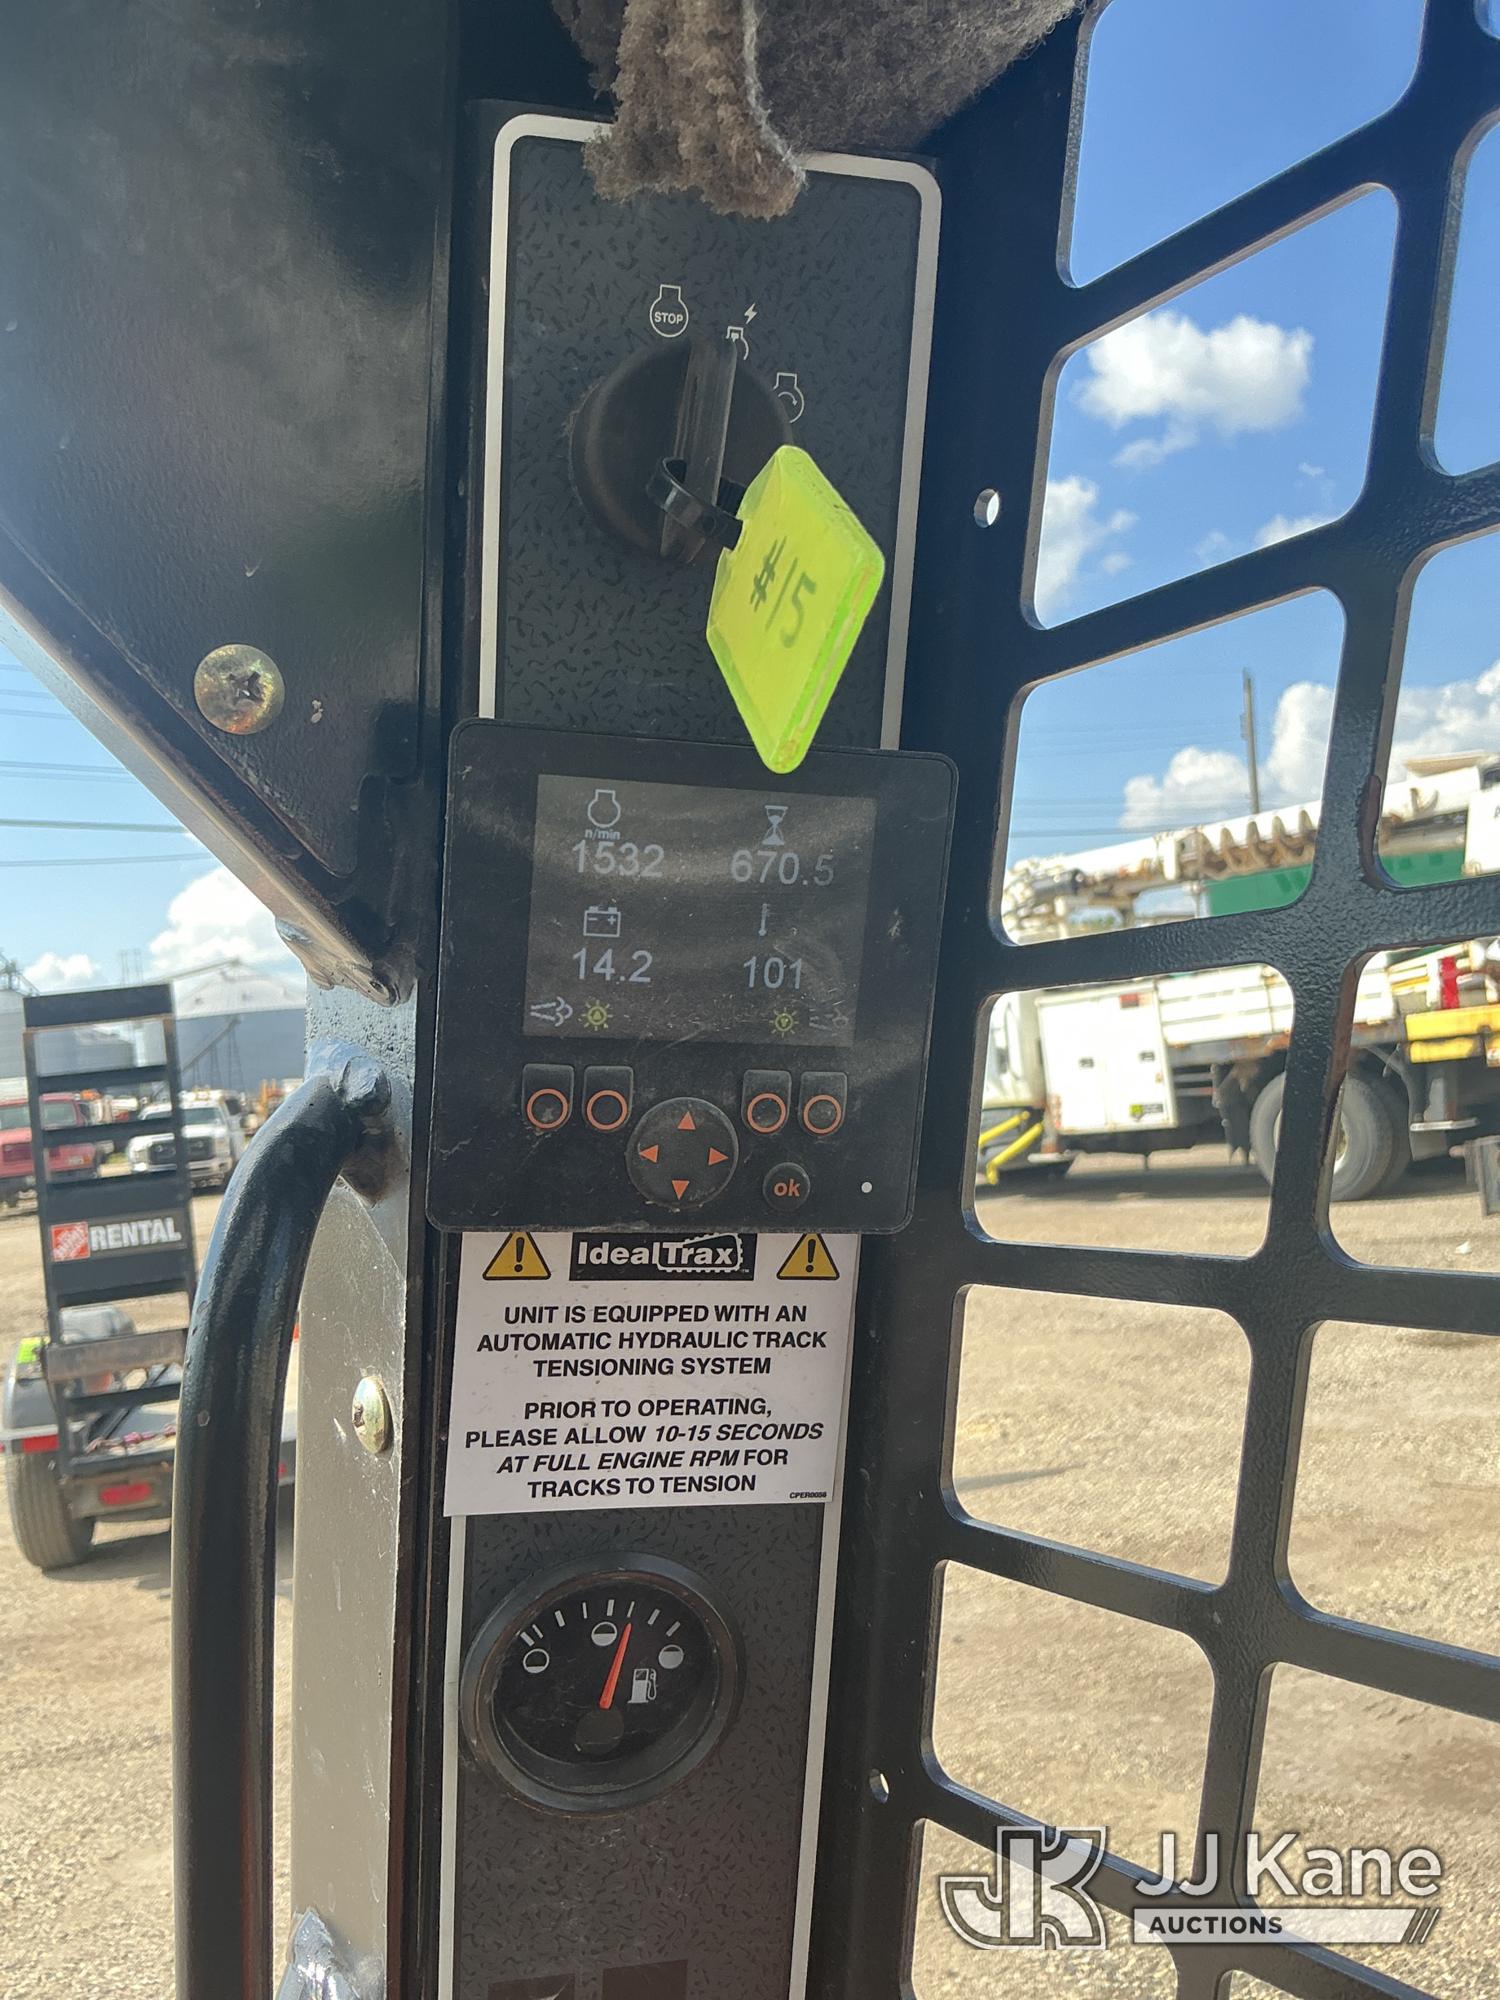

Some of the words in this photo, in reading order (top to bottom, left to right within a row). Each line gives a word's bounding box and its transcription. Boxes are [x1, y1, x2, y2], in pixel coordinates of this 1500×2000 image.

[654, 311, 684, 325] STOP
[585, 828, 621, 841] n/min
[572, 839, 665, 878] 1532
[730, 850, 835, 887] 670.5
[572, 946, 654, 984] 14.2
[743, 956, 803, 990] 101
[773, 1178, 801, 1198] ok
[89, 1217, 182, 1251] RENTAL
[577, 1240, 734, 1266] IdealTrax
[504, 1305, 559, 1325] UNIT
[564, 1305, 586, 1324] IS
[592, 1304, 709, 1324] EQUIPPED
[714, 1304, 770, 1322] WITH
[774, 1305, 807, 1323] AN
[476, 1331, 612, 1353] AUTOMATIC
[618, 1330, 749, 1350] HYDRAULIC
[753, 1330, 828, 1349] TRACK
[532, 1357, 674, 1378] TENSIONING
[680, 1357, 772, 1376] SYSTEM
[524, 1400, 597, 1420] PRIOR
[600, 1399, 631, 1418] TO
[637, 1397, 772, 1418] OPERATING,
[465, 1428, 558, 1449] PLEASE
[563, 1425, 647, 1446] ALLOW
[655, 1424, 712, 1443] 10-15
[715, 1422, 824, 1441] SECONDS
[496, 1455, 530, 1475] AT
[532, 1453, 592, 1473] FULL
[597, 1450, 686, 1470] ENGINE
[689, 1449, 741, 1468] RPM
[743, 1448, 790, 1466] FOR
[527, 1478, 621, 1499] TRACKS
[625, 1476, 655, 1496] TO
[659, 1474, 756, 1494] TENSION
